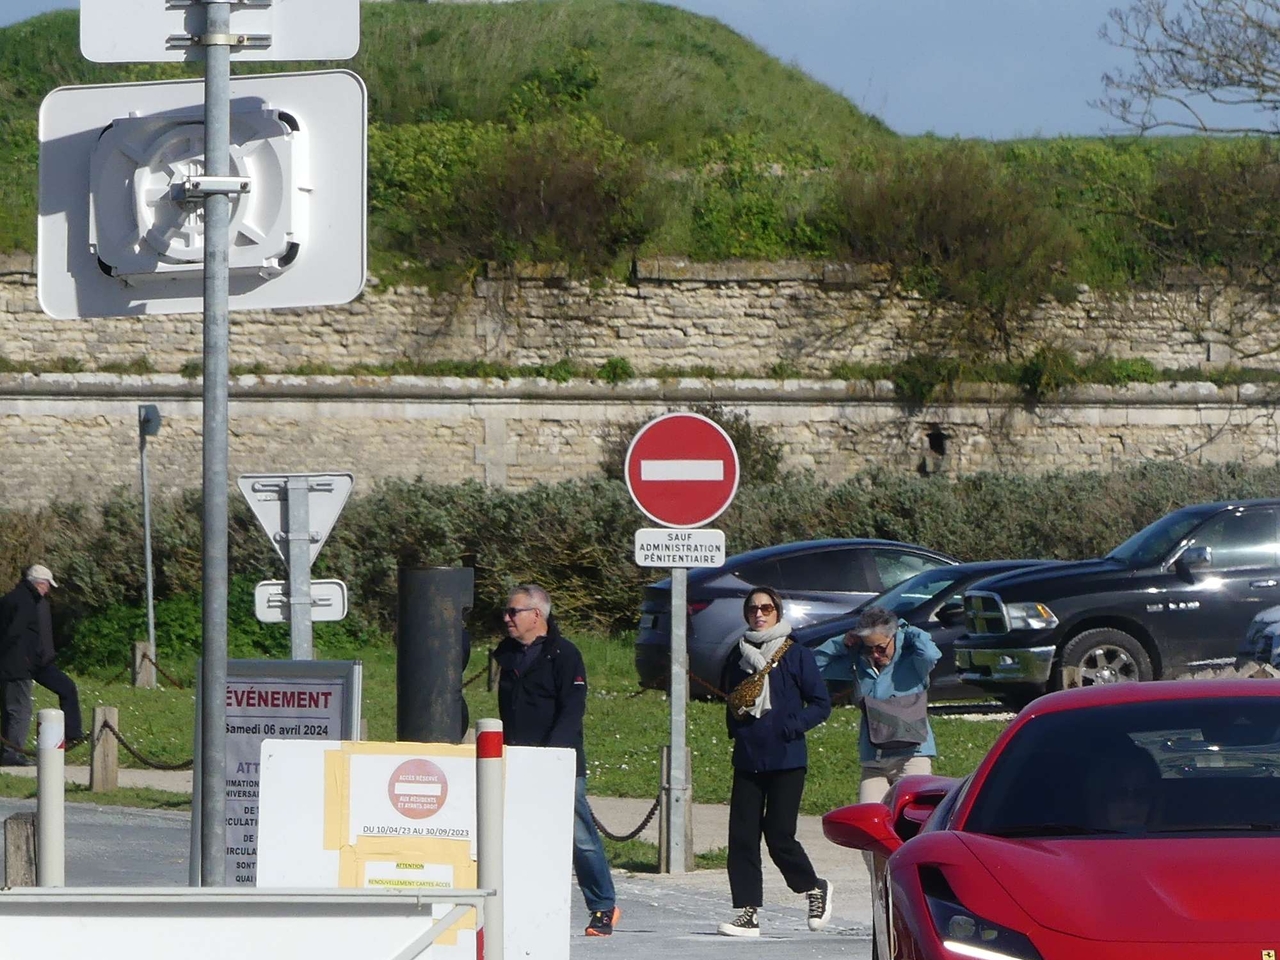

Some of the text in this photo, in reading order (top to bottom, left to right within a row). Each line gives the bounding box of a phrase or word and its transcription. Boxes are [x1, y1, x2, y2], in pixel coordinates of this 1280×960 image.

[667, 533, 693, 542] SAUF
[639, 543, 721, 553] ADMINISTRATION
[643, 552, 716, 563] PÉNITENTIAIRE
[225, 723, 329, 736] Samedi 06 avril 2024
[363, 825, 375, 834] DU
[377, 826, 411, 835] 10/04/23
[426, 828, 469, 837] 30/09/2023
